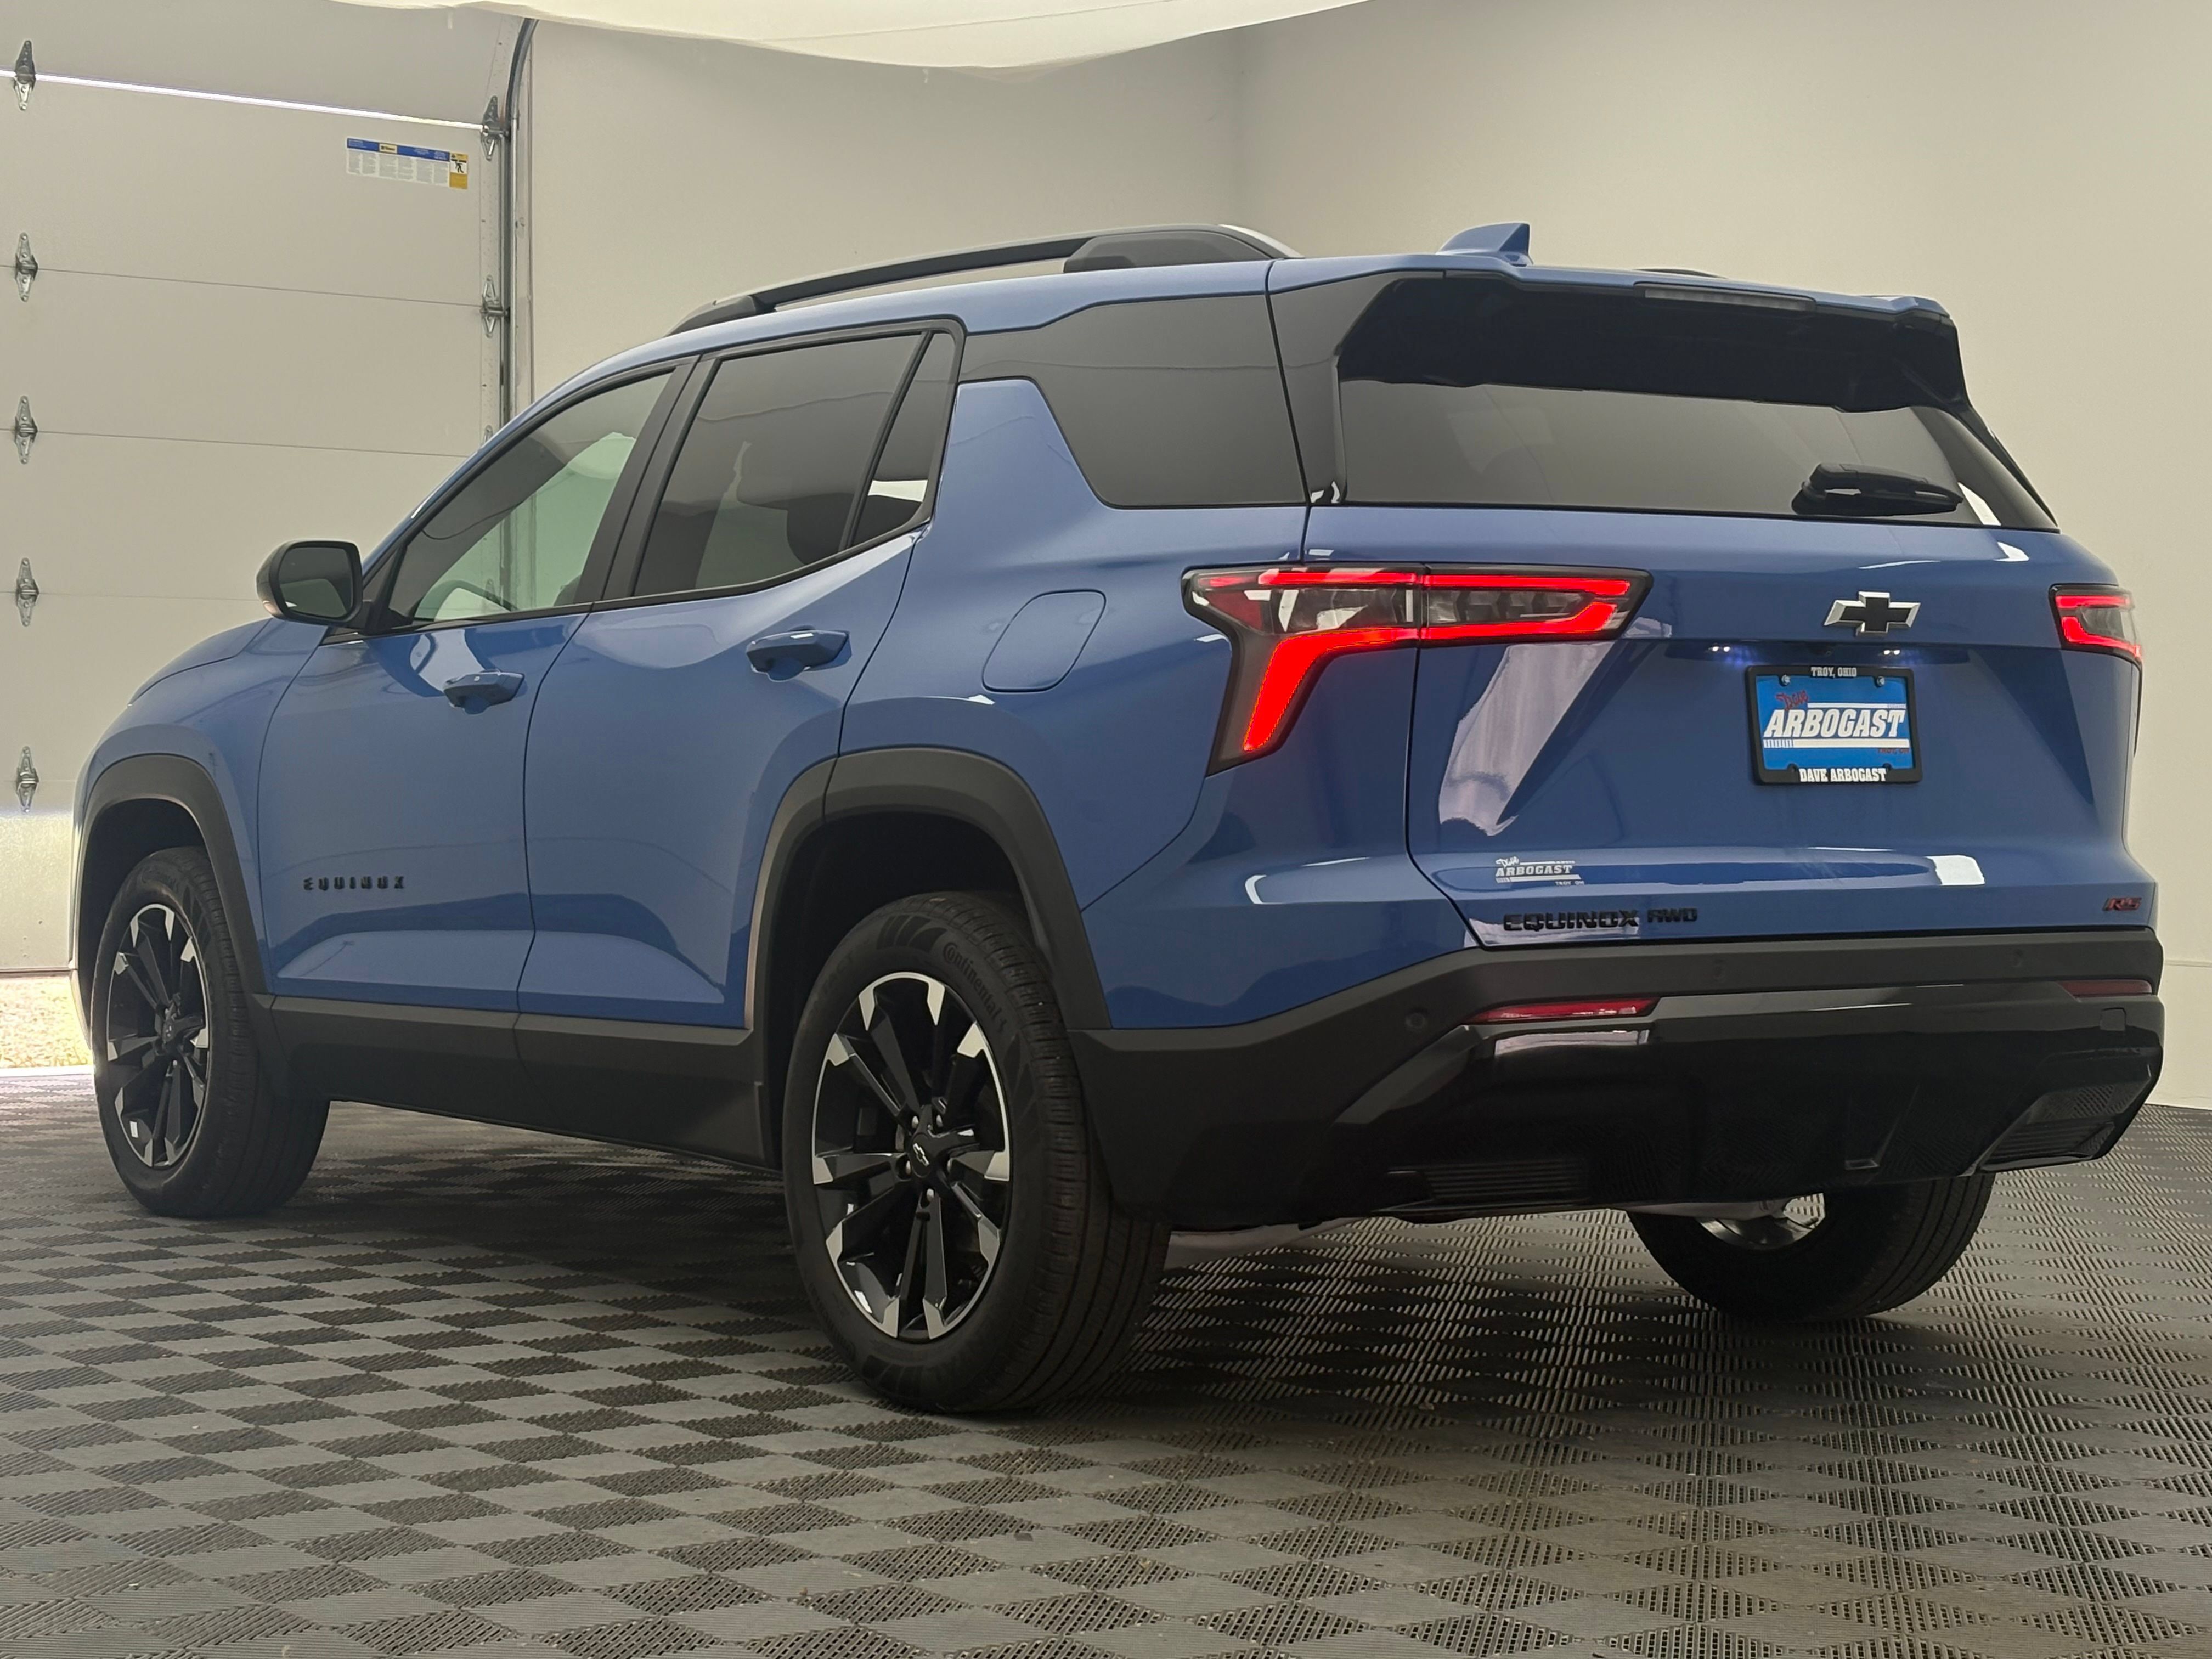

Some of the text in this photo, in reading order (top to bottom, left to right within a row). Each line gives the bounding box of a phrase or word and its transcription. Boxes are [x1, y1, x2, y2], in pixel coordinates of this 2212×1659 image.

[1810, 667, 1857, 678] TROY, OHIO
[1763, 709, 1906, 738] ARBOGAST
[1799, 768, 1887, 782] DAVE ARBOGAST
[1495, 865, 1573, 877] ARBOGAST
[302, 876, 404, 891] EQUINOX
[2102, 897, 2142, 911] RS
[1503, 907, 1698, 932] EQUINOX AWD
[943, 941, 1002, 1021] Continental
